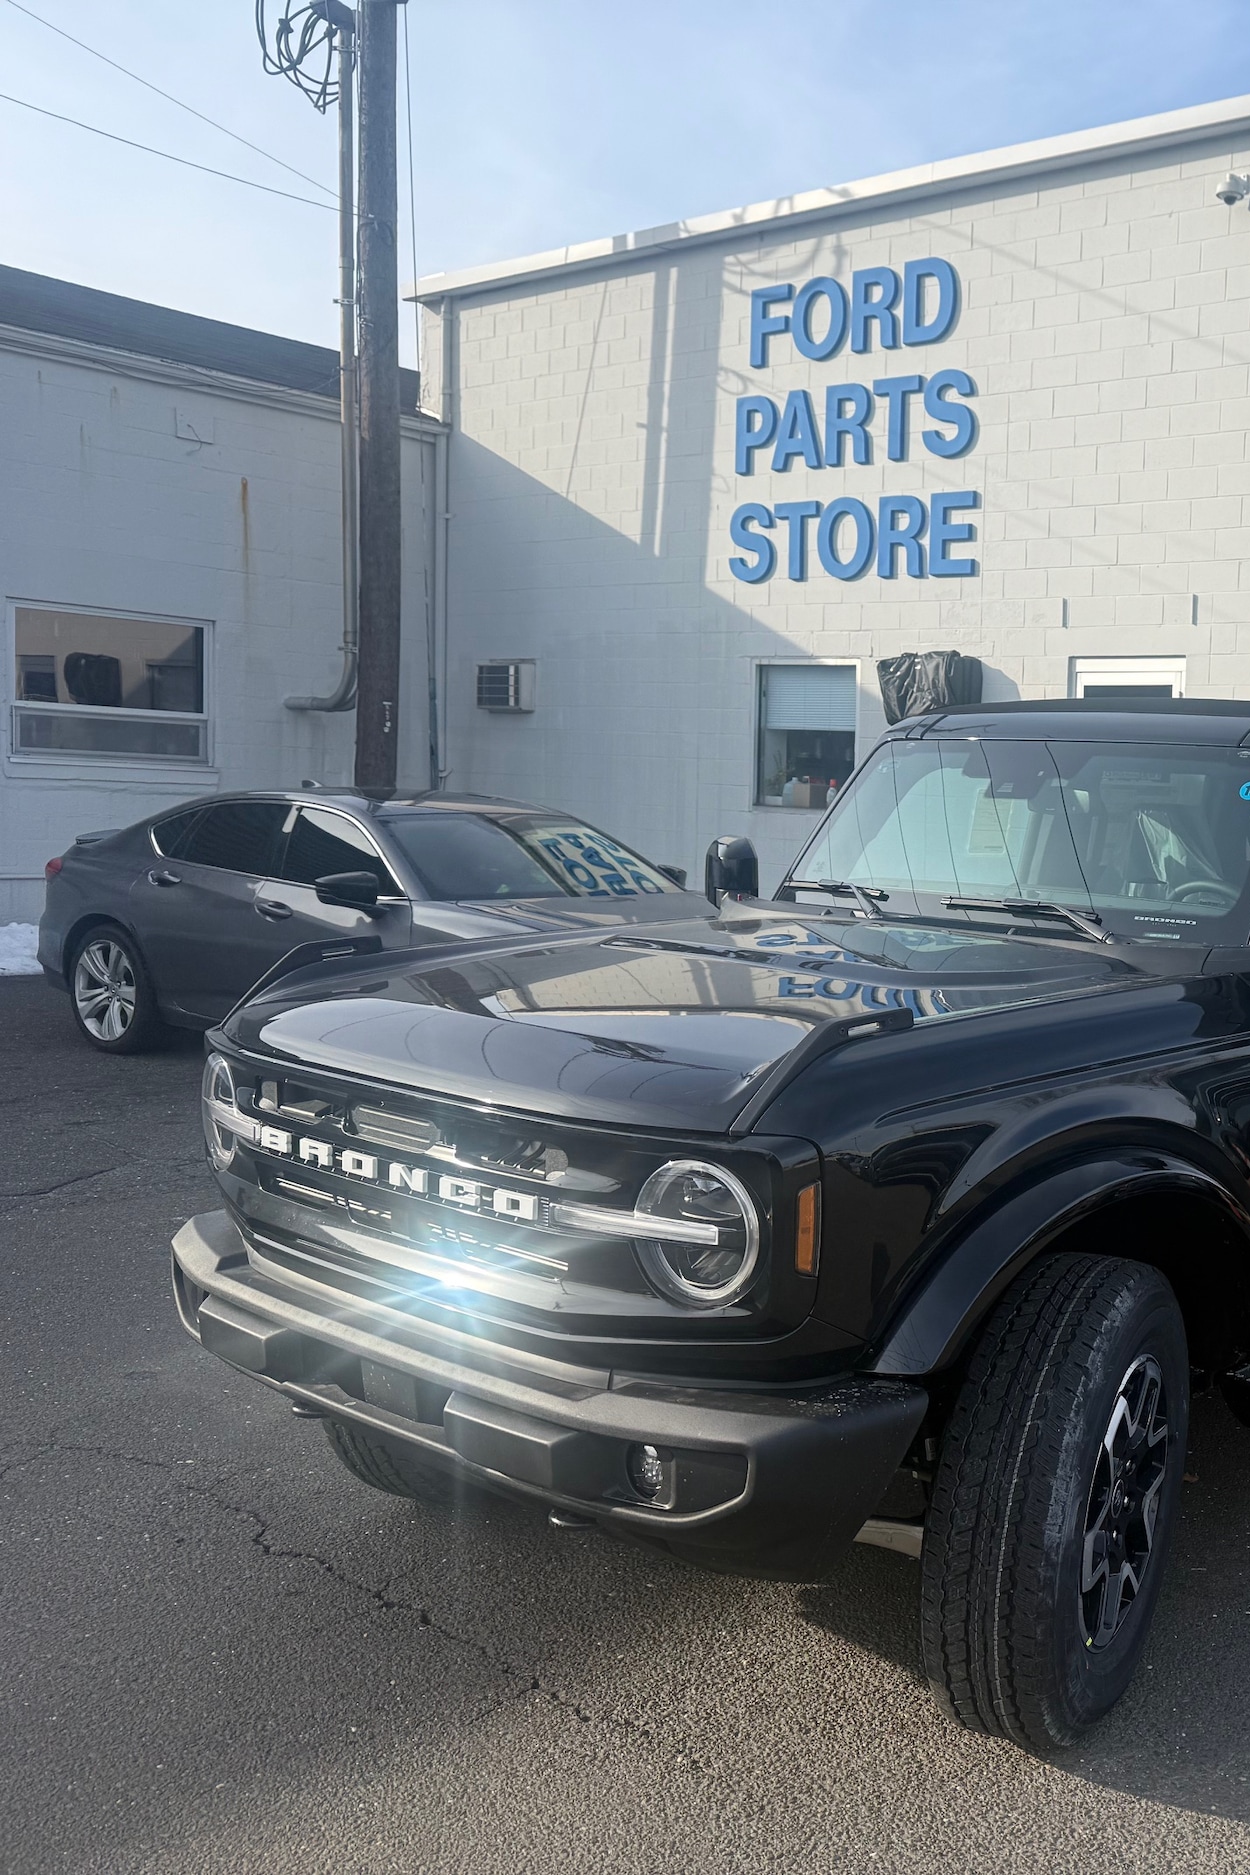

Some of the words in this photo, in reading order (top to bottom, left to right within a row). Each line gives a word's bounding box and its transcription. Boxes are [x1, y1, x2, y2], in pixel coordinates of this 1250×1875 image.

[750, 256, 963, 369] FORD
[734, 368, 980, 476] PARTS
[728, 490, 982, 584] STORE
[1134, 915, 1197, 925] BRONCO
[260, 1125, 540, 1221] BRONCO
